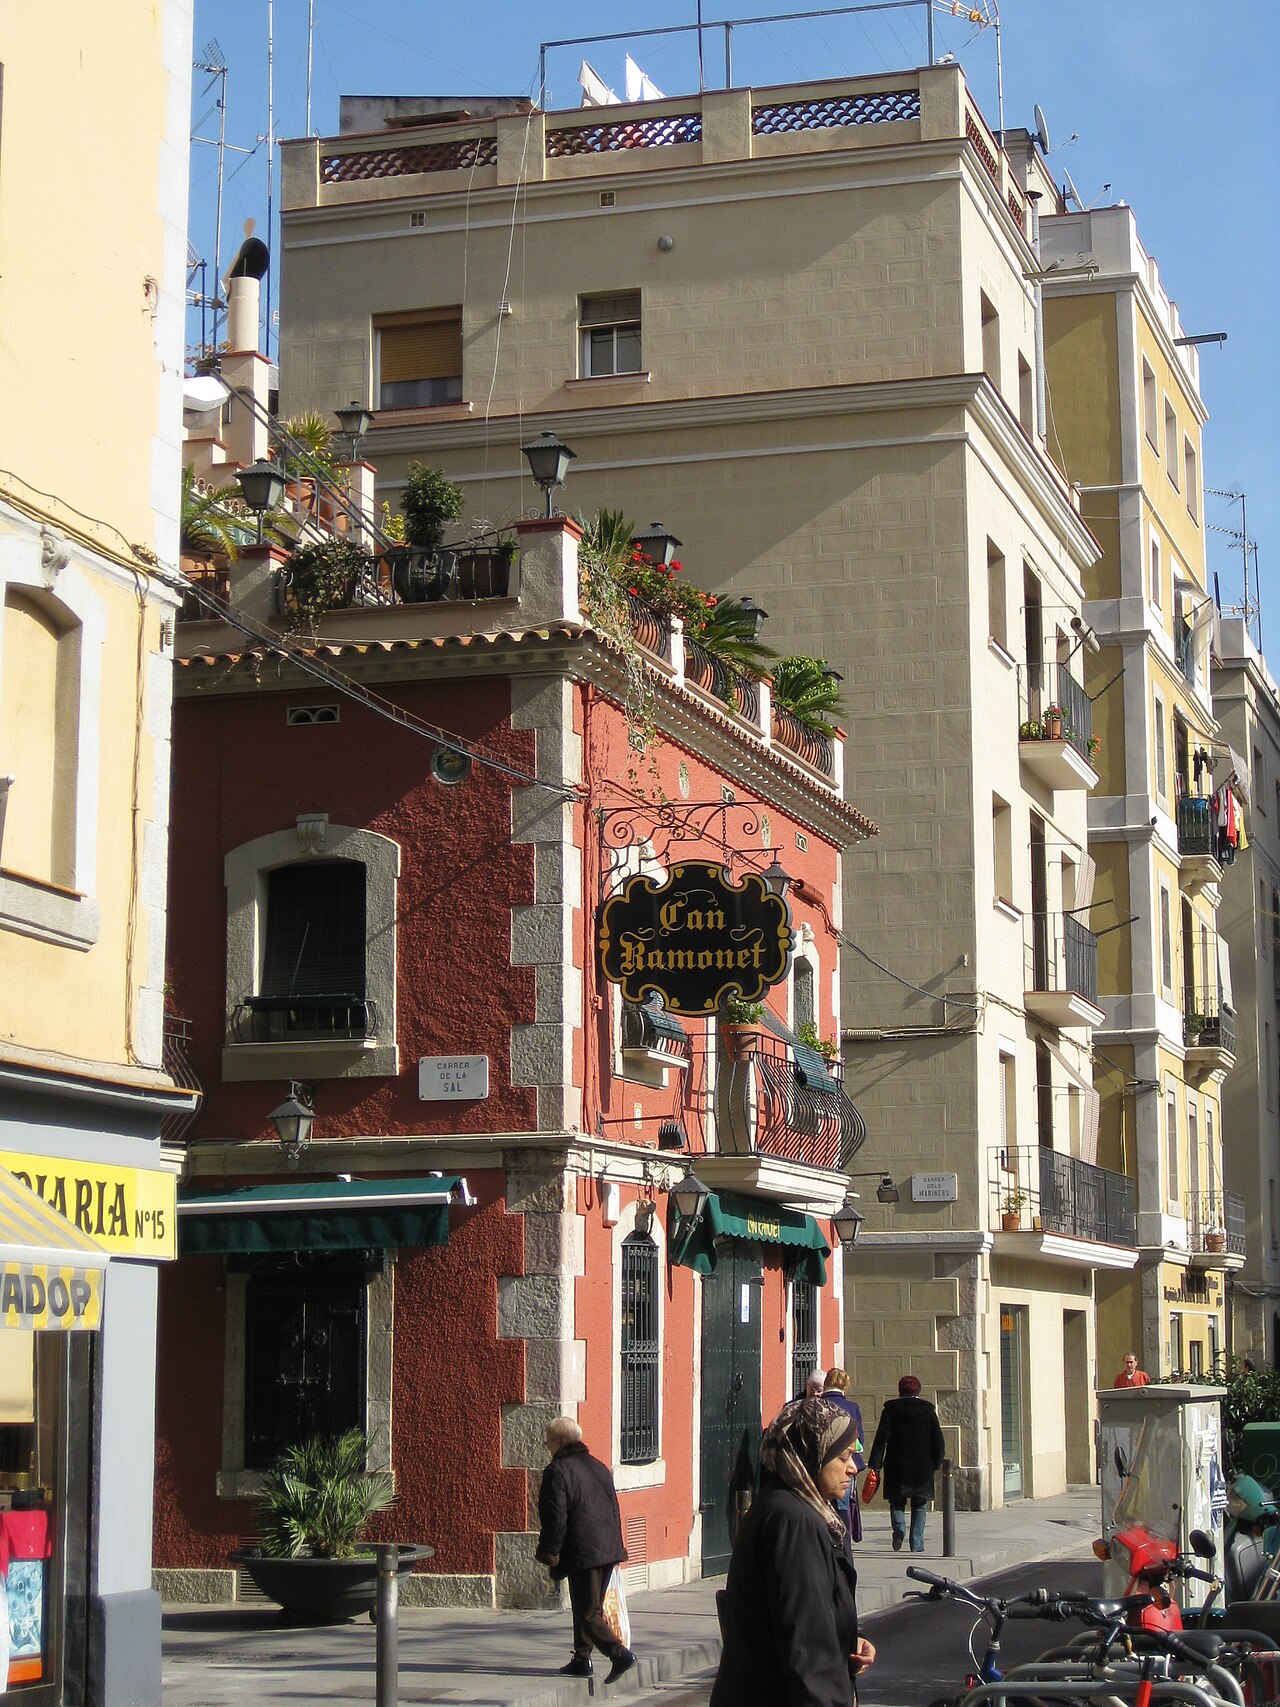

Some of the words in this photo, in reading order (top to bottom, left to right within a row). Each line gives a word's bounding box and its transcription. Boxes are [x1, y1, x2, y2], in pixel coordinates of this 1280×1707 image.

[659, 896, 727, 936] Can
[620, 937, 767, 974] Ramonet
[437, 1062, 470, 1070] CARRER
[440, 1072, 451, 1080] DE
[443, 1082, 463, 1093] SAL
[11, 1171, 129, 1238] ARIA
[0, 1273, 92, 1318] ADOR
